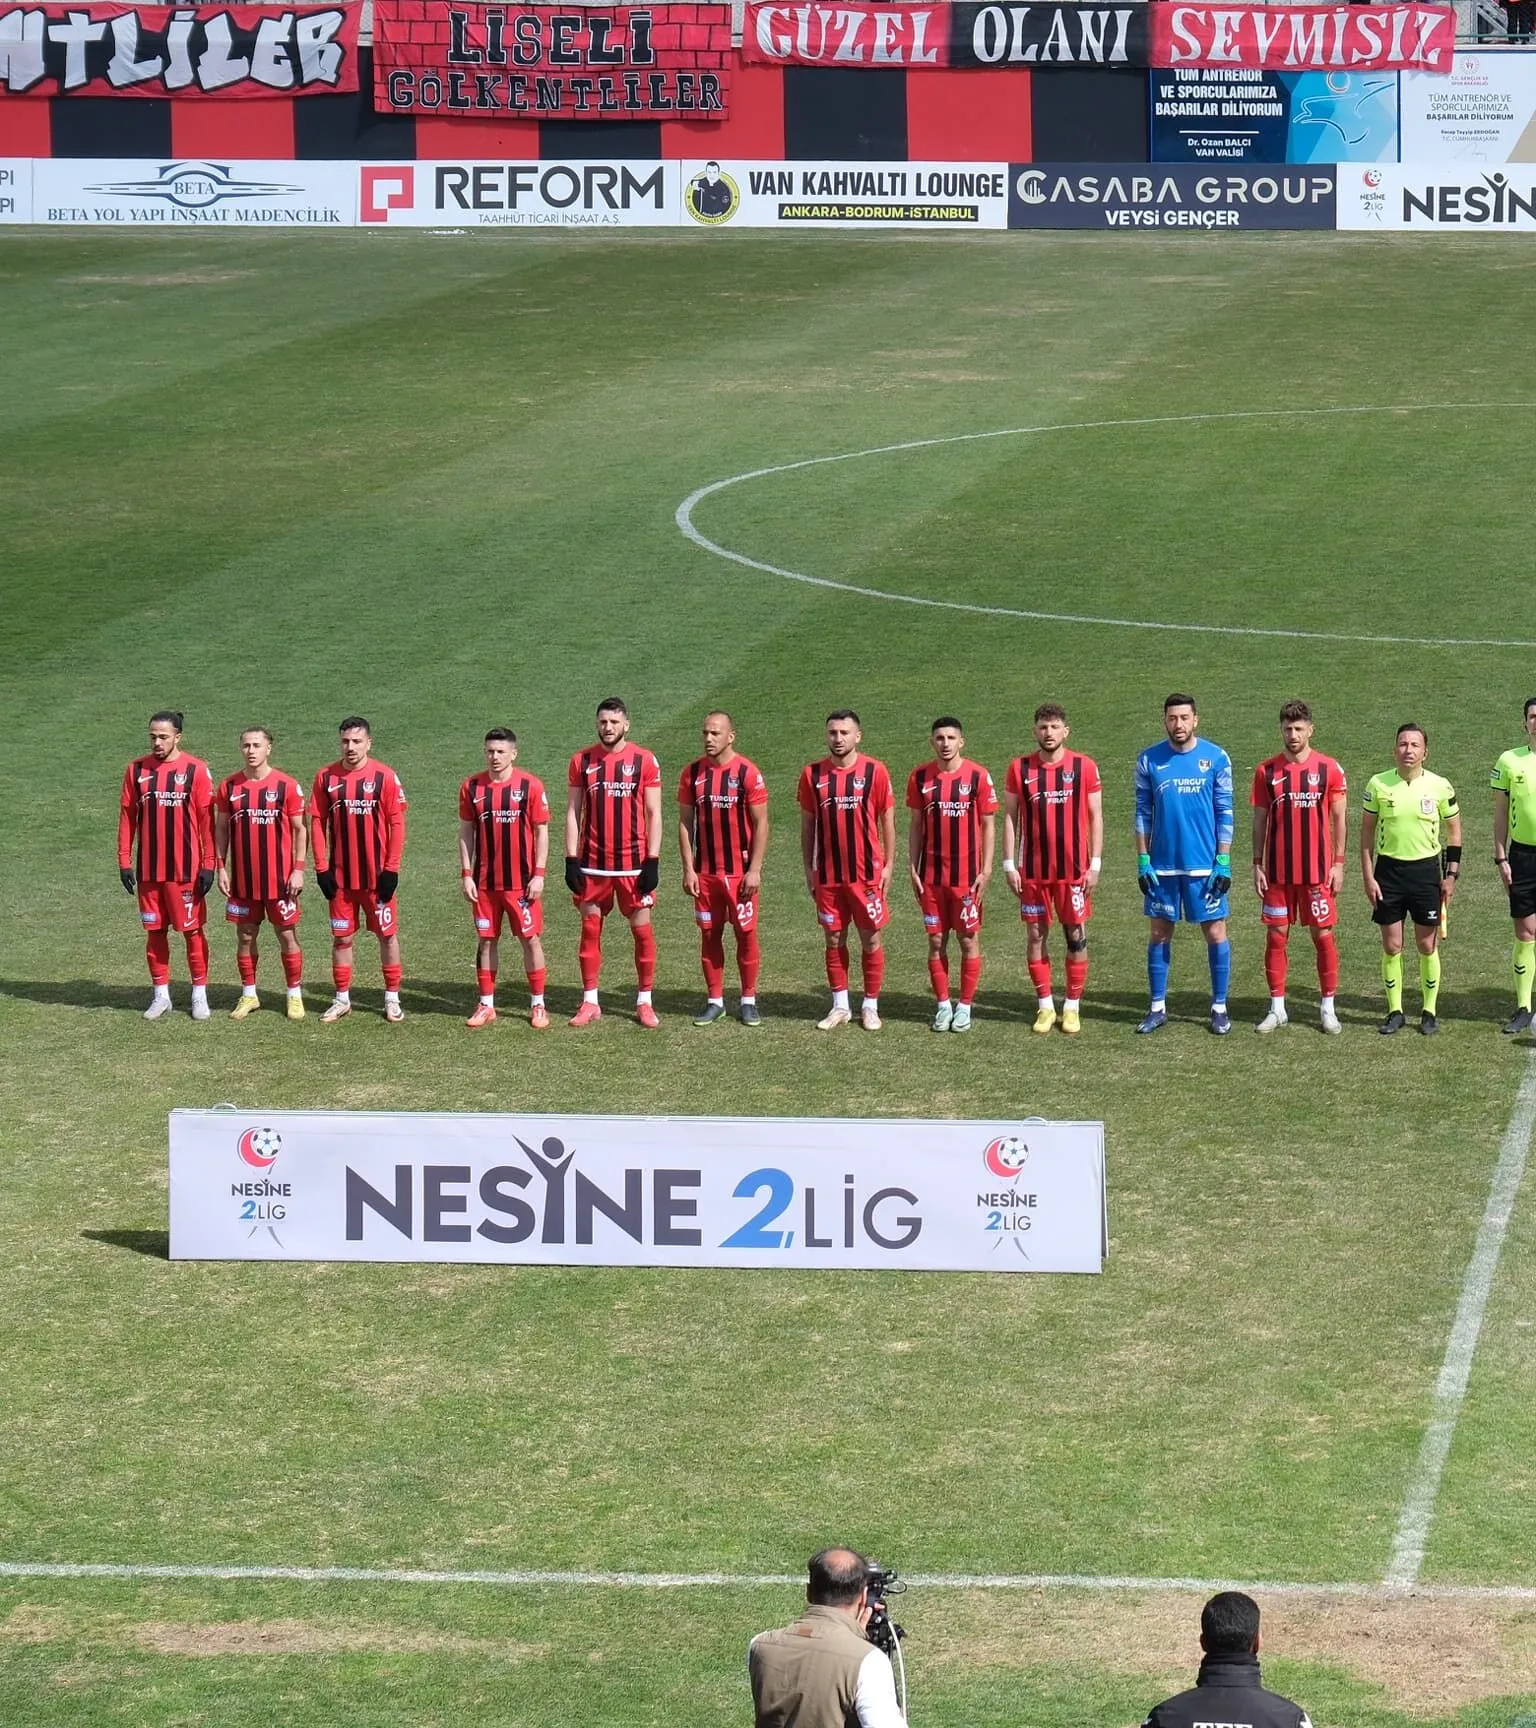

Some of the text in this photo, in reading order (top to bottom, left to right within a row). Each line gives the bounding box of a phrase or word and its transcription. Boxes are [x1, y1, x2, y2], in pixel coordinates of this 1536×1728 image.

[448, 9, 653, 66] LİSELİ
[756, 3, 1448, 66] GÜZEL OLANI SEVMİŞİZ
[1160, 85, 1277, 99] VE SPORCULARIMIZA
[1429, 93, 1512, 102] TÜM ANTRENÖR VE
[1155, 100, 1283, 117] BAŞARILAR DİLİYORUM
[1431, 103, 1509, 112] SPORCULARIMIZA
[1426, 112, 1514, 122] BAŞARILAR DİLİYORUM
[1187, 138, 1200, 146] Dr.
[1201, 138, 1224, 146] Ozan
[1195, 147, 1244, 157] VAN VALİSİ
[174, 182, 216, 195] BETA
[435, 166, 664, 209] REFORM
[749, 171, 1004, 198] VAN KAHVALTI LOUNGE
[1016, 169, 1333, 205] CASABA GROUP
[48, 204, 342, 224] BETA YOL YAPI İNŞAAT MADENCİLİK
[1163, 210, 1240, 230] GENÇER
[1173, 778, 1207, 786] TURGUT
[608, 790, 632, 798] FIRAT
[1043, 789, 1074, 798] TURGUT
[1178, 786, 1201, 794] FIRAT
[154, 791, 188, 800] TURGUT
[1288, 792, 1322, 800] TURGUT
[159, 799, 183, 807] FIRAT
[344, 799, 377, 807] TURGUT
[938, 801, 972, 809] TURGUT
[1294, 800, 1318, 808] FIRAT
[246, 809, 280, 817] TURGUT
[349, 807, 373, 815] FIRAT
[943, 809, 966, 817] FIRAT
[252, 817, 275, 825] FIRAT
[184, 903, 193, 919] 7
[277, 900, 297, 916] 34
[736, 902, 753, 921] 23
[865, 898, 882, 919] 55
[958, 903, 978, 922] 44
[1311, 900, 1330, 918] 65
[373, 907, 392, 926] 76
[521, 909, 532, 926] 3
